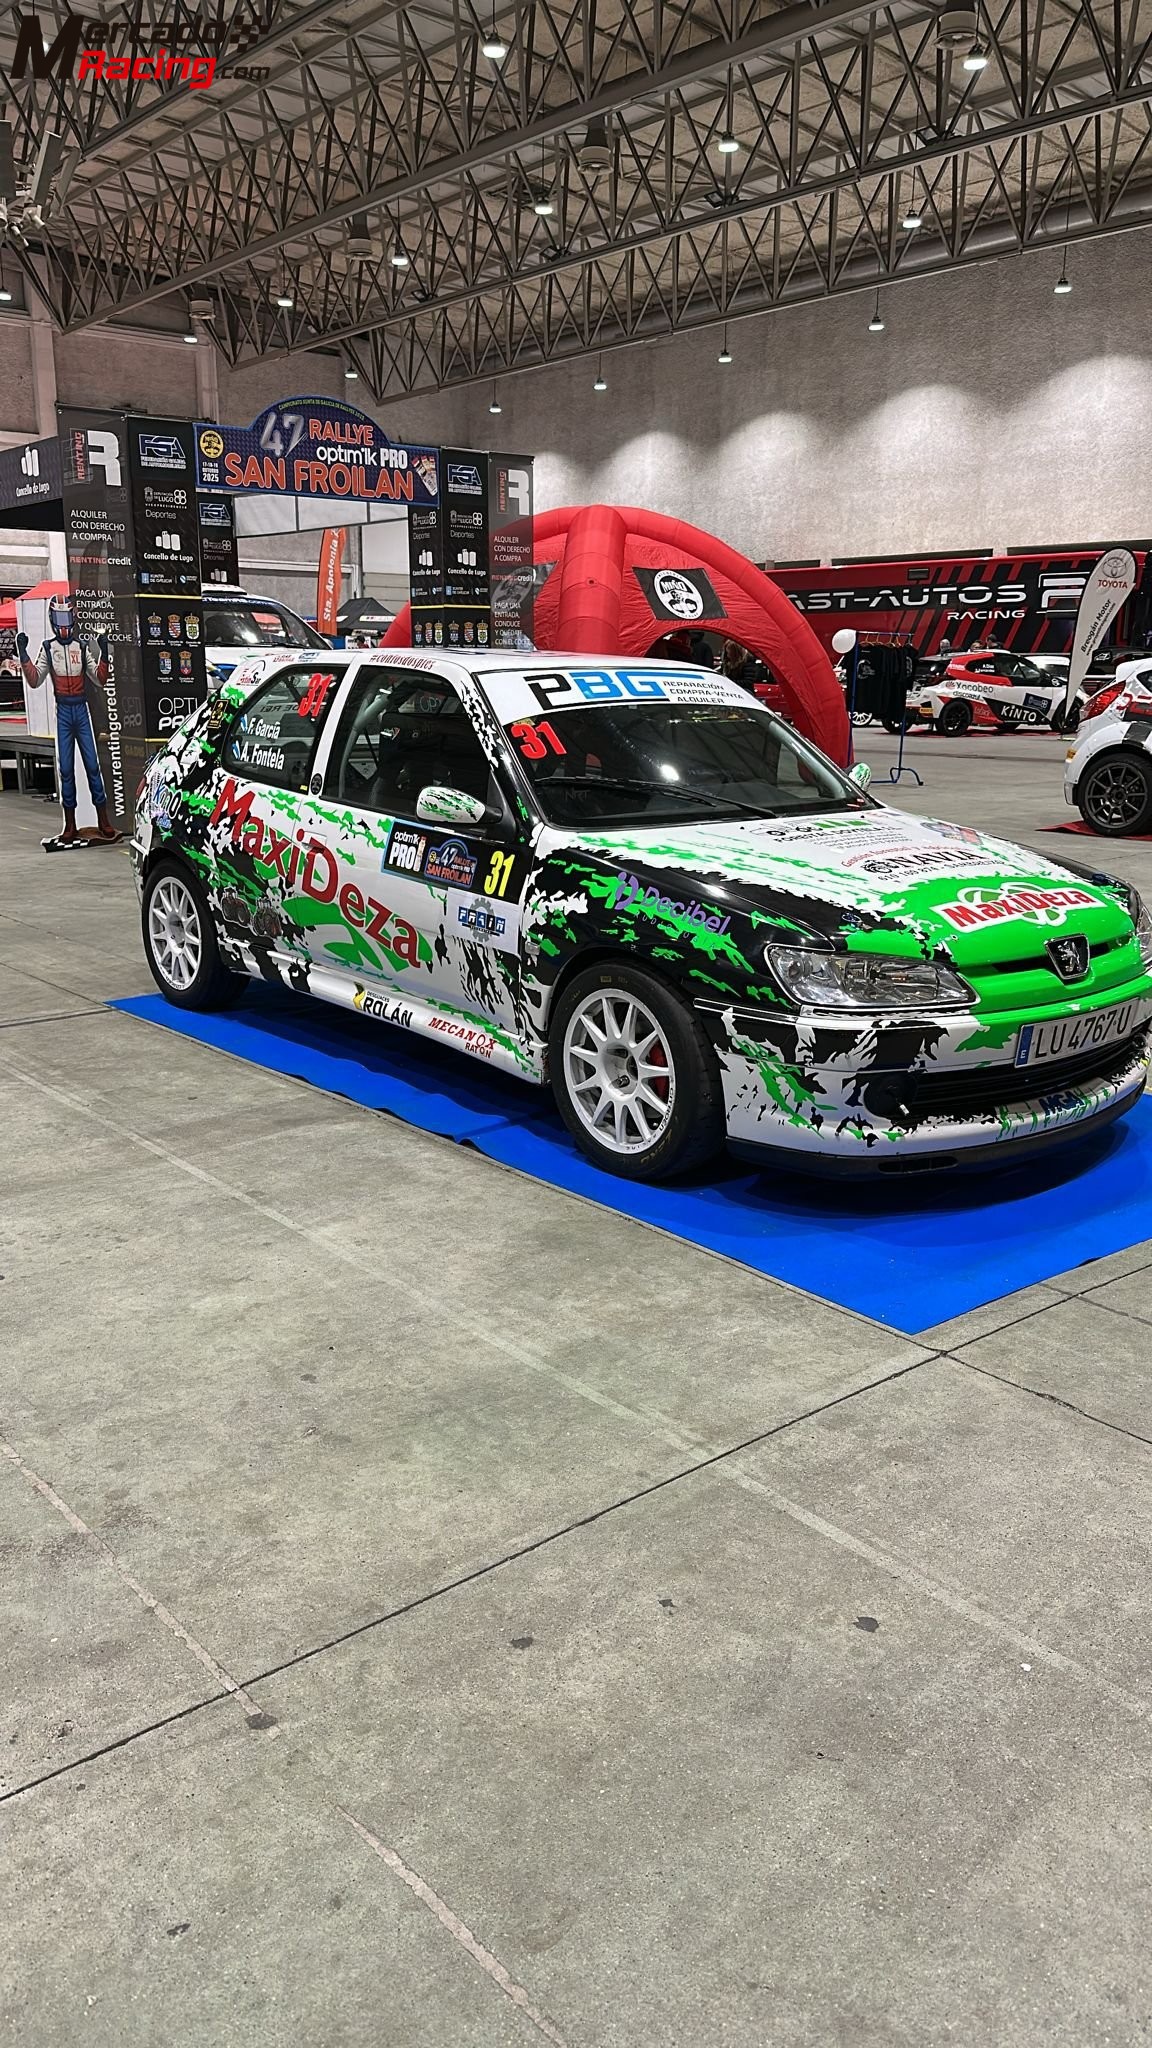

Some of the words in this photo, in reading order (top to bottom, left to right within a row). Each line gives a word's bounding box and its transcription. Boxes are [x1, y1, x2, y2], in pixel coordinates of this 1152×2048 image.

[260, 411, 304, 456] 47
[308, 418, 374, 446] RALLYE
[74, 432, 85, 480] RENTING
[87, 430, 122, 486] R
[380, 447, 407, 469] PRO
[203, 473, 219, 482] 2025
[224, 453, 286, 489] SAN
[294, 460, 413, 501] FROILAN
[70, 509, 108, 519] ALQUILER
[145, 509, 177, 519] Deportes
[71, 521, 89, 530] CON
[90, 521, 125, 532] DERECHO
[72, 532, 79, 540] A
[80, 532, 113, 541] COMPRA
[494, 535, 519, 544] ALQUILER
[507, 546, 531, 554] DERECHO
[143, 552, 169, 560] Concello
[180, 555, 194, 563] Lugo
[325, 540, 339, 594] Apolonia
[75, 589, 97, 598] PAGA
[98, 590, 115, 598] UNA
[1098, 579, 1128, 588] TOYOTA
[76, 600, 114, 609] ENTRADA,
[323, 599, 332, 622] Sta.
[77, 611, 115, 620] CONDUCE
[77, 622, 84, 630] Y
[494, 620, 521, 628] CONDUCE
[947, 610, 1025, 621] RACING
[1080, 620, 1099, 653] Breogán
[1095, 598, 1112, 622] Motor
[79, 633, 95, 641] CON
[107, 633, 132, 642] COCHE
[298, 673, 334, 718] 31
[523, 671, 705, 712] PBG
[663, 680, 725, 690] REPARACIÓN
[669, 688, 745, 700] COMPRA-VENTA
[677, 696, 725, 705] ALQUILER
[158, 715, 194, 731] PR
[248, 718, 256, 734] F.
[255, 719, 281, 739] García
[511, 721, 567, 759] 31
[240, 742, 250, 762] A.
[251, 743, 285, 770] Fontela
[388, 841, 417, 870] PRO
[441, 846, 459, 867] 47
[209, 778, 421, 969] MaxiDeza
[427, 863, 441, 876] SAN
[440, 866, 472, 885] FROILAN
[484, 850, 516, 898] 31
[640, 886, 732, 936] Decibel
[942, 889, 1097, 928] MaxiDeza
[363, 996, 414, 1028] ROLÁN
[428, 1017, 498, 1050] MECANOX
[1035, 1023, 1067, 1058] LU
[1067, 1009, 1118, 1050] 4767
[464, 1042, 493, 1059] RATON
[1020, 1049, 1027, 1059] E
